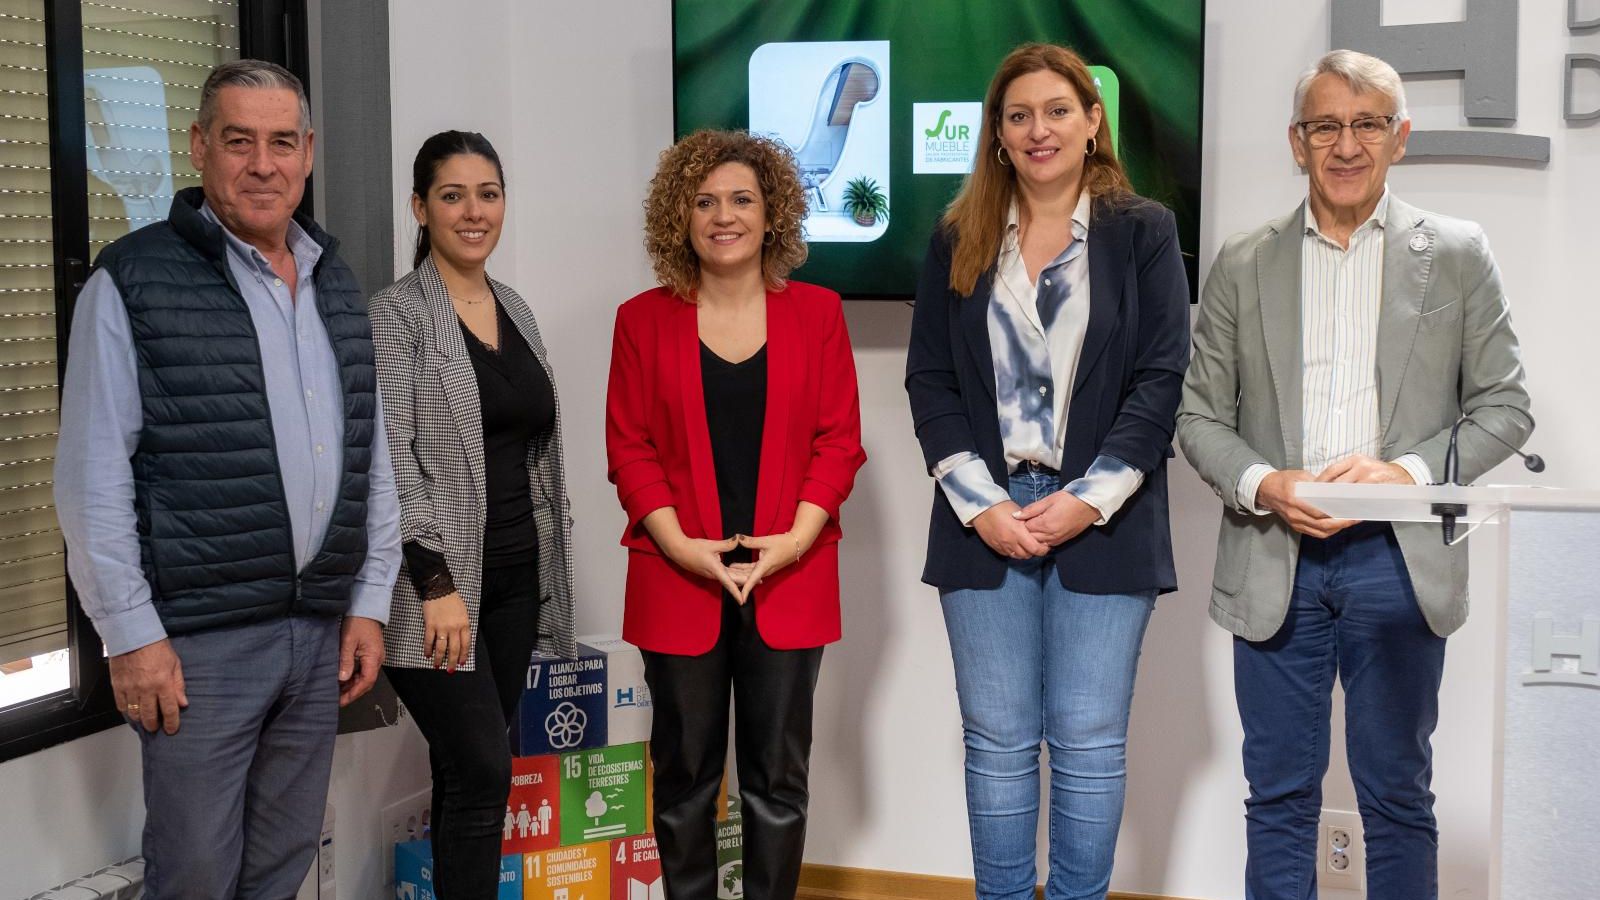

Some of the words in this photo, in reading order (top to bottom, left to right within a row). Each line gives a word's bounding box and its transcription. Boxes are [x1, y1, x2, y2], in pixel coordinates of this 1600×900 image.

[925, 109, 970, 140] SUR
[925, 141, 970, 152] MUEBLE
[549, 661, 584, 676] ALIANZAS
[585, 659, 604, 670] PARA
[526, 664, 541, 689] 17
[549, 675, 578, 687] LOGRAR
[549, 688, 563, 700] LOS
[564, 683, 603, 698] OBJETIVOS
[564, 755, 582, 780] 15
[588, 753, 605, 765] VIDA
[588, 765, 598, 777] DE
[598, 760, 643, 776] ECOSISTEMAS
[588, 774, 630, 789] TERRESTRES
[718, 838, 731, 850] POR
[732, 836, 740, 848] EL
[546, 849, 581, 863] CIUDADES
[582, 847, 588, 856] Y
[616, 841, 627, 865] 4
[633, 852, 643, 863] DE
[526, 854, 541, 879] 11
[546, 858, 597, 876] COMUNIDADES
[546, 870, 593, 887] SOSTENIBLES
